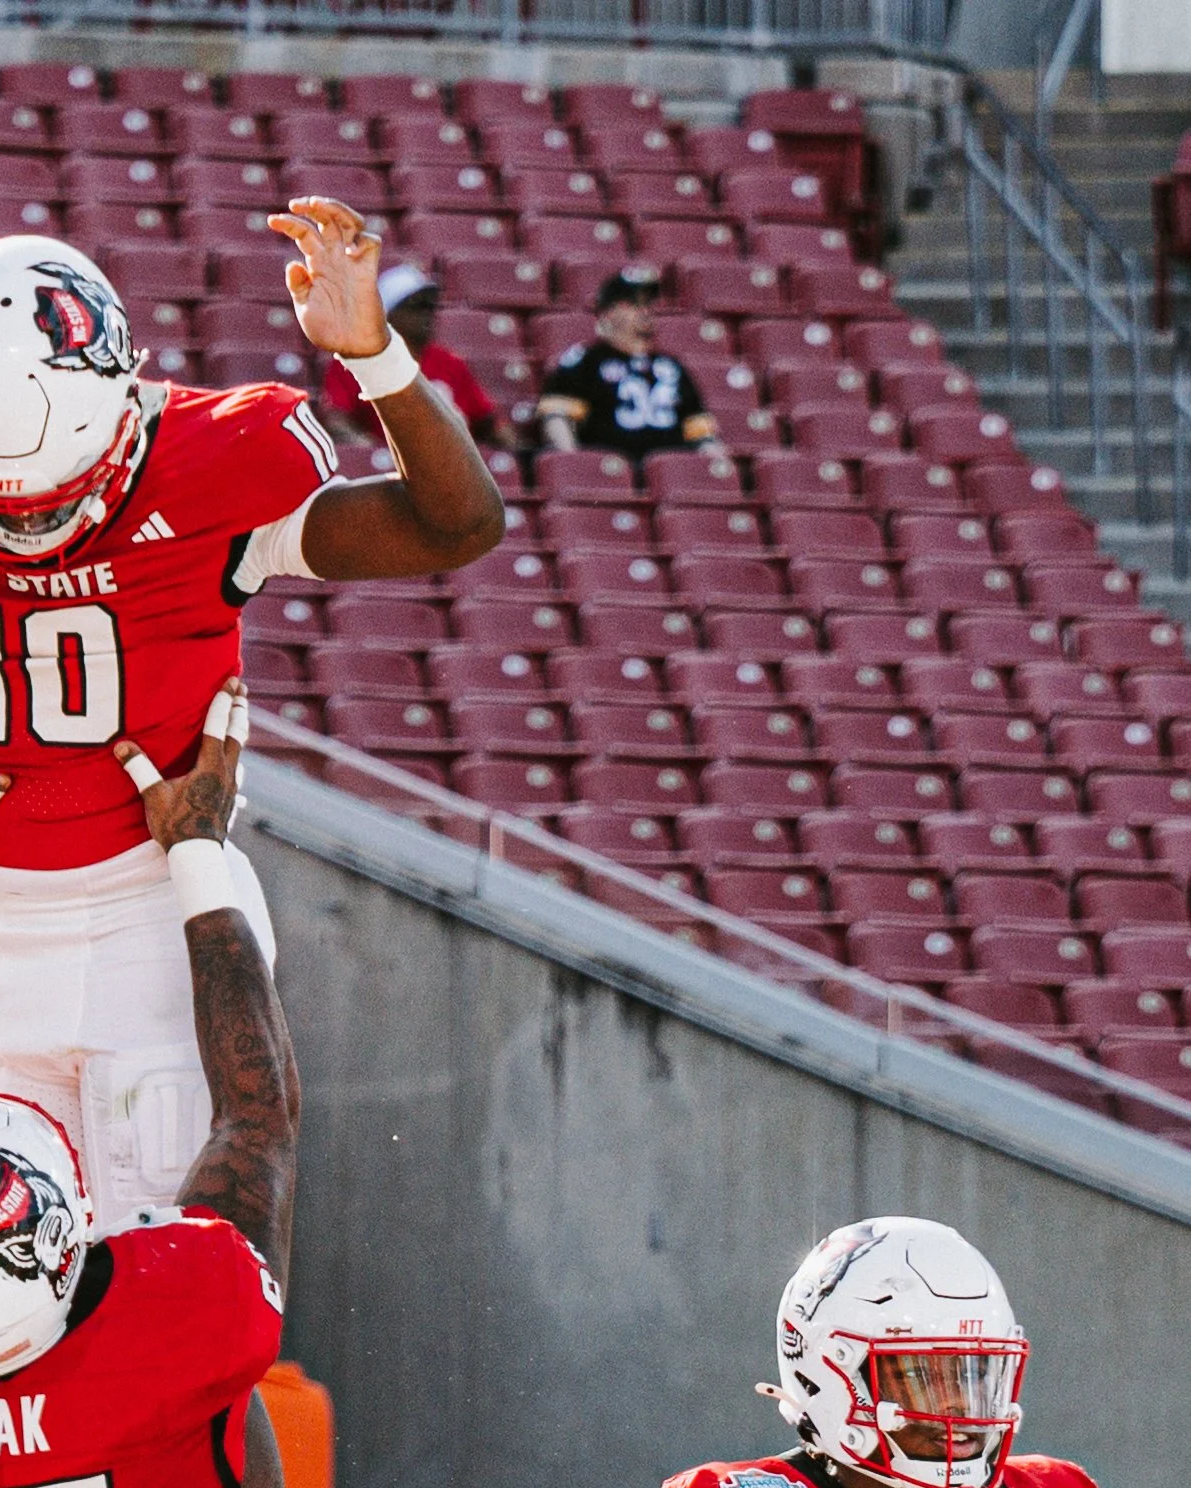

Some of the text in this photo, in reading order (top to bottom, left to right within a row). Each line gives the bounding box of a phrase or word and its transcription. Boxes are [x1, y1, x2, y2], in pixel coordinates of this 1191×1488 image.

[280, 399, 339, 484] 10
[6, 561, 118, 598] STATE
[1, 1180, 28, 1215] STATE
[958, 1319, 984, 1335] HTT
